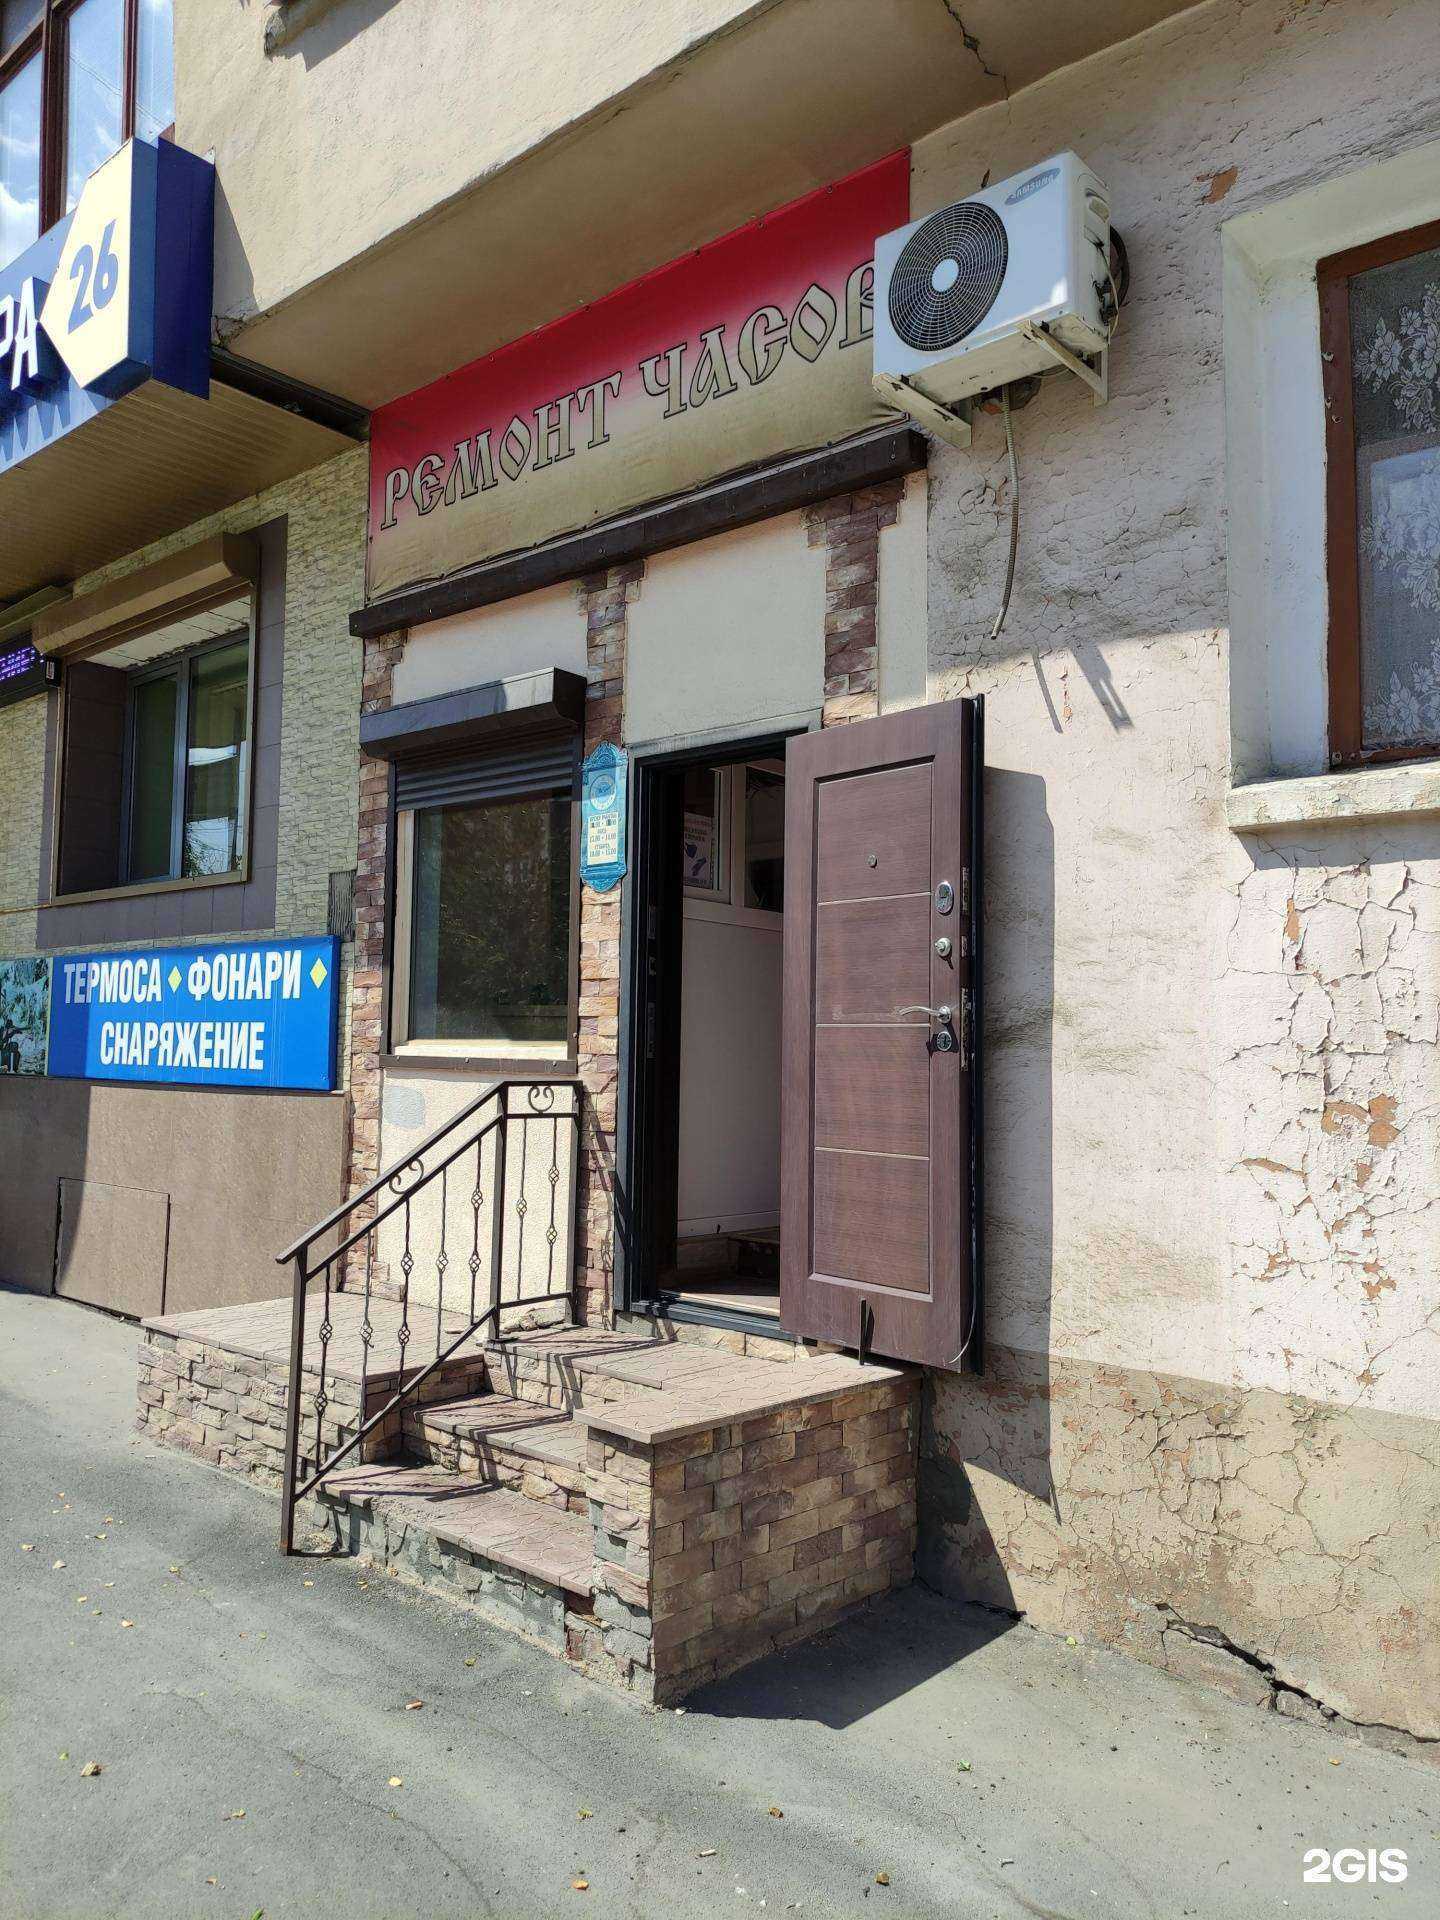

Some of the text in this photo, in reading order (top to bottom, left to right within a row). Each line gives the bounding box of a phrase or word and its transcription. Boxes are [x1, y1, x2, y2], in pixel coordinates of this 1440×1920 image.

[68, 218, 119, 334] 26
[380, 370, 622, 531] РЕМОНТ
[63, 949, 302, 1004] ТЕРМОСА ФОНАРИ
[99, 1020, 265, 1070] СНАРЯЖЕНИЕ
